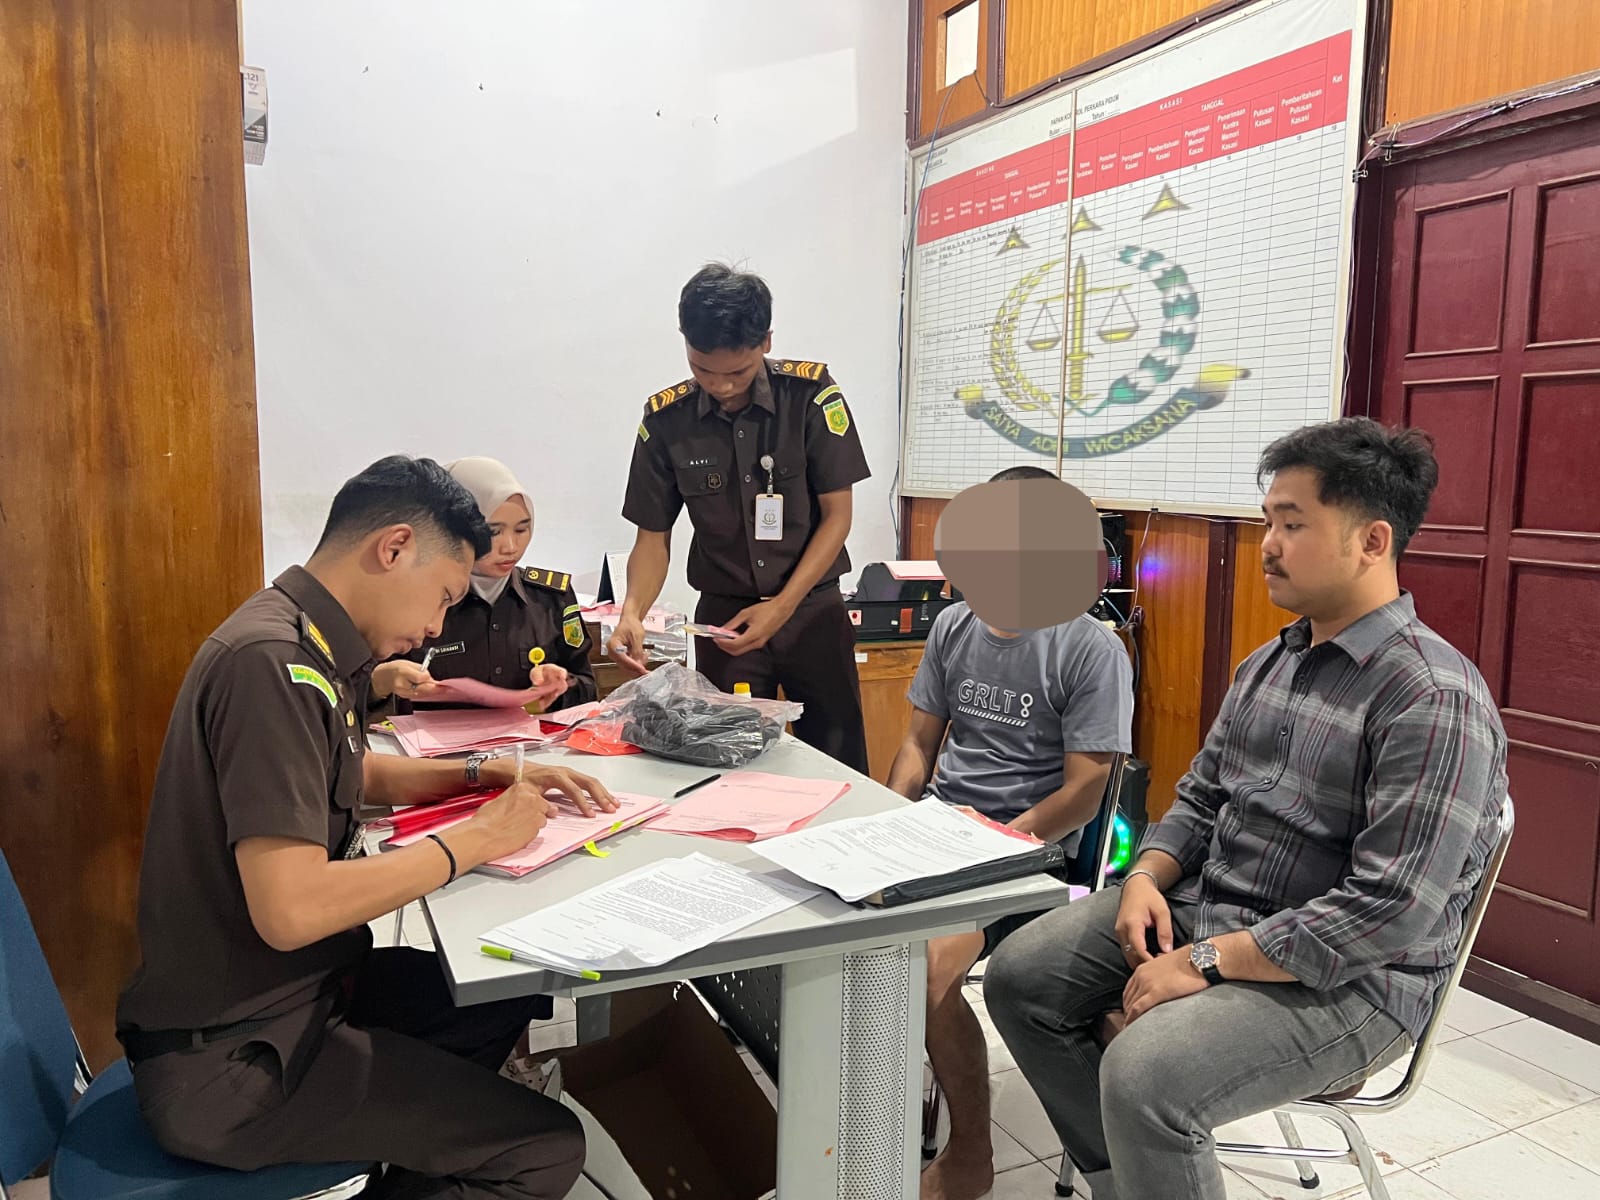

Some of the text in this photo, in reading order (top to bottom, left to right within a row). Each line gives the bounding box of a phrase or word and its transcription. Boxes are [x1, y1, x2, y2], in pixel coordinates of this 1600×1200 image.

[1281, 89, 1322, 106] Pemberitahuan
[1160, 98, 1183, 110] KASASI
[1201, 99, 1225, 112] TANGGAL
[1289, 103, 1312, 115] Putusan
[1253, 107, 1275, 118] Putusan
[1255, 117, 1272, 128] Kasasi
[1291, 113, 1310, 126] Kasasi
[1221, 142, 1238, 151] Kasasi
[985, 406, 1021, 439] SATYA
[1085, 399, 1197, 453] WICAKSANA
[958, 679, 1016, 713] GRLT
